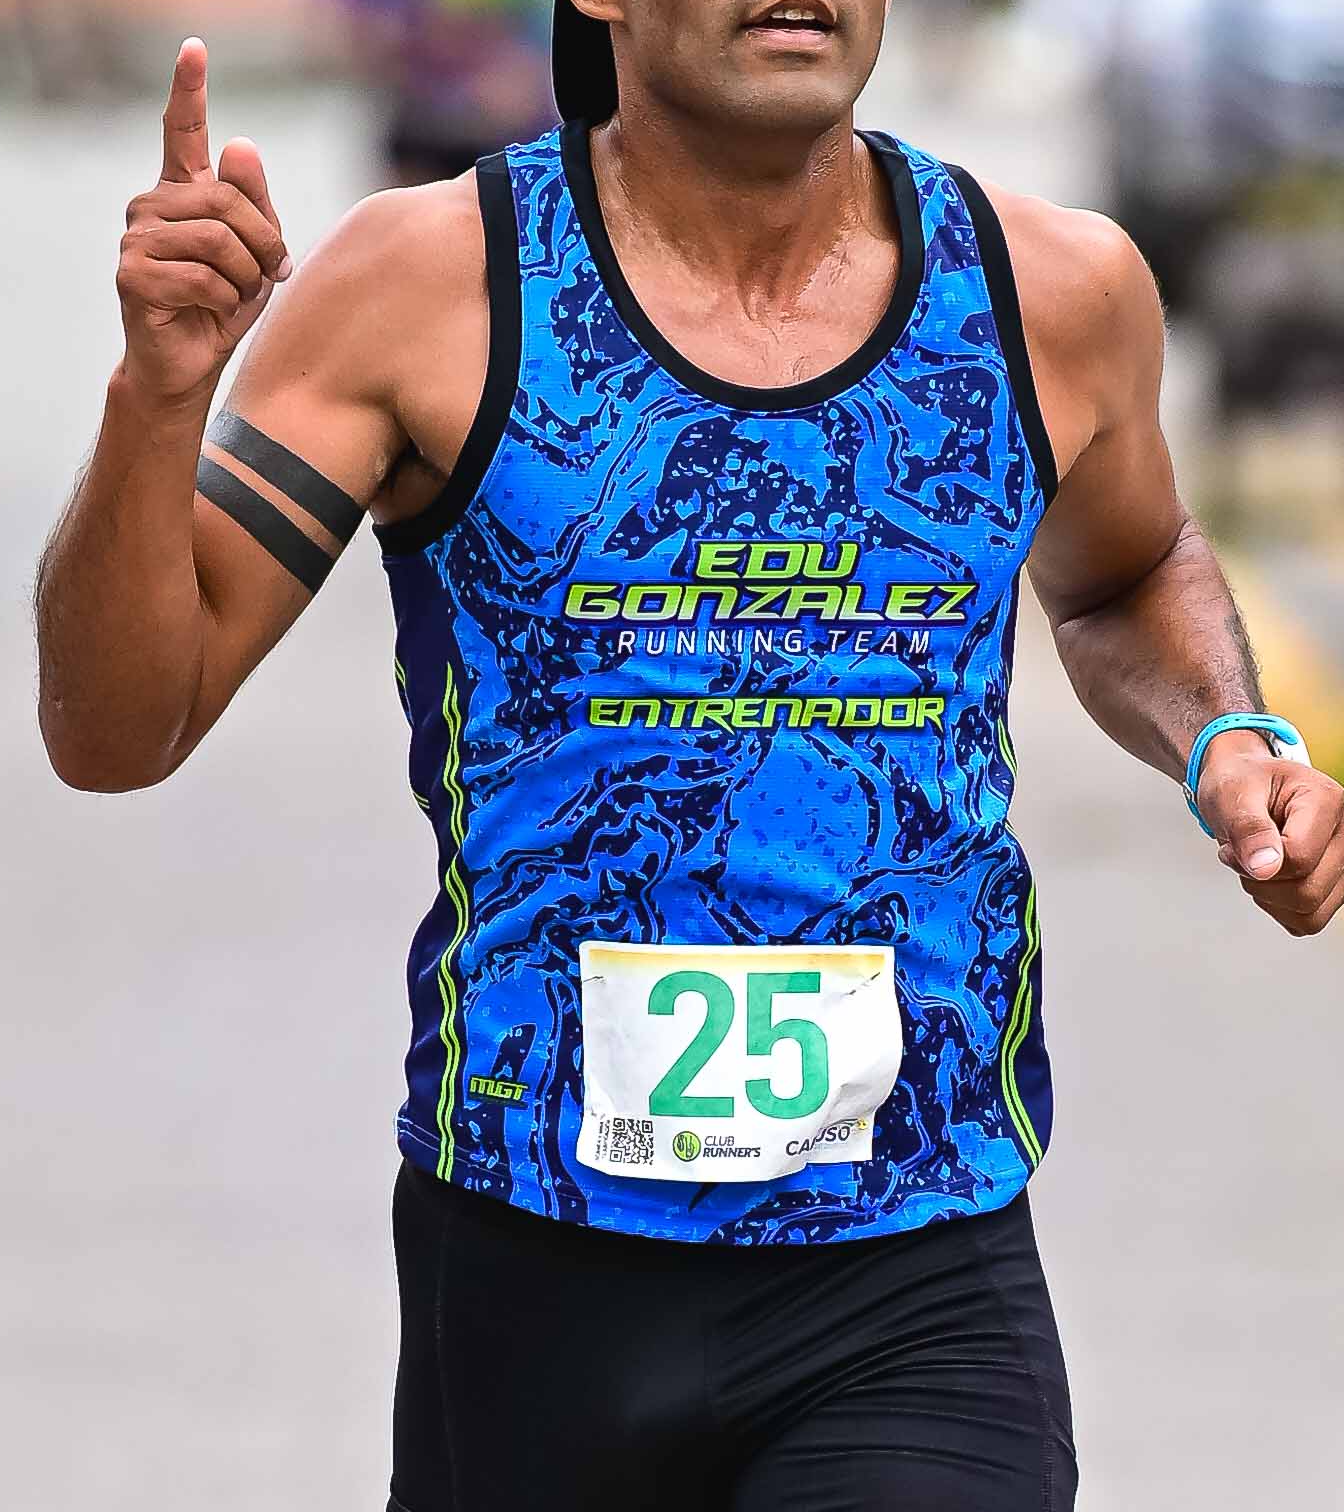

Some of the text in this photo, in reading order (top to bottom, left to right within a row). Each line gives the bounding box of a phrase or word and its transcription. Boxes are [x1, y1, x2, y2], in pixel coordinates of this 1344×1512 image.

[695, 542, 858, 580] EDU
[564, 583, 977, 621] GONZALEZ
[617, 628, 931, 655] RUNNING TEAM
[589, 696, 945, 735] ENTRENADOR
[647, 970, 830, 1120] 25
[704, 1135, 735, 1147] CLUB
